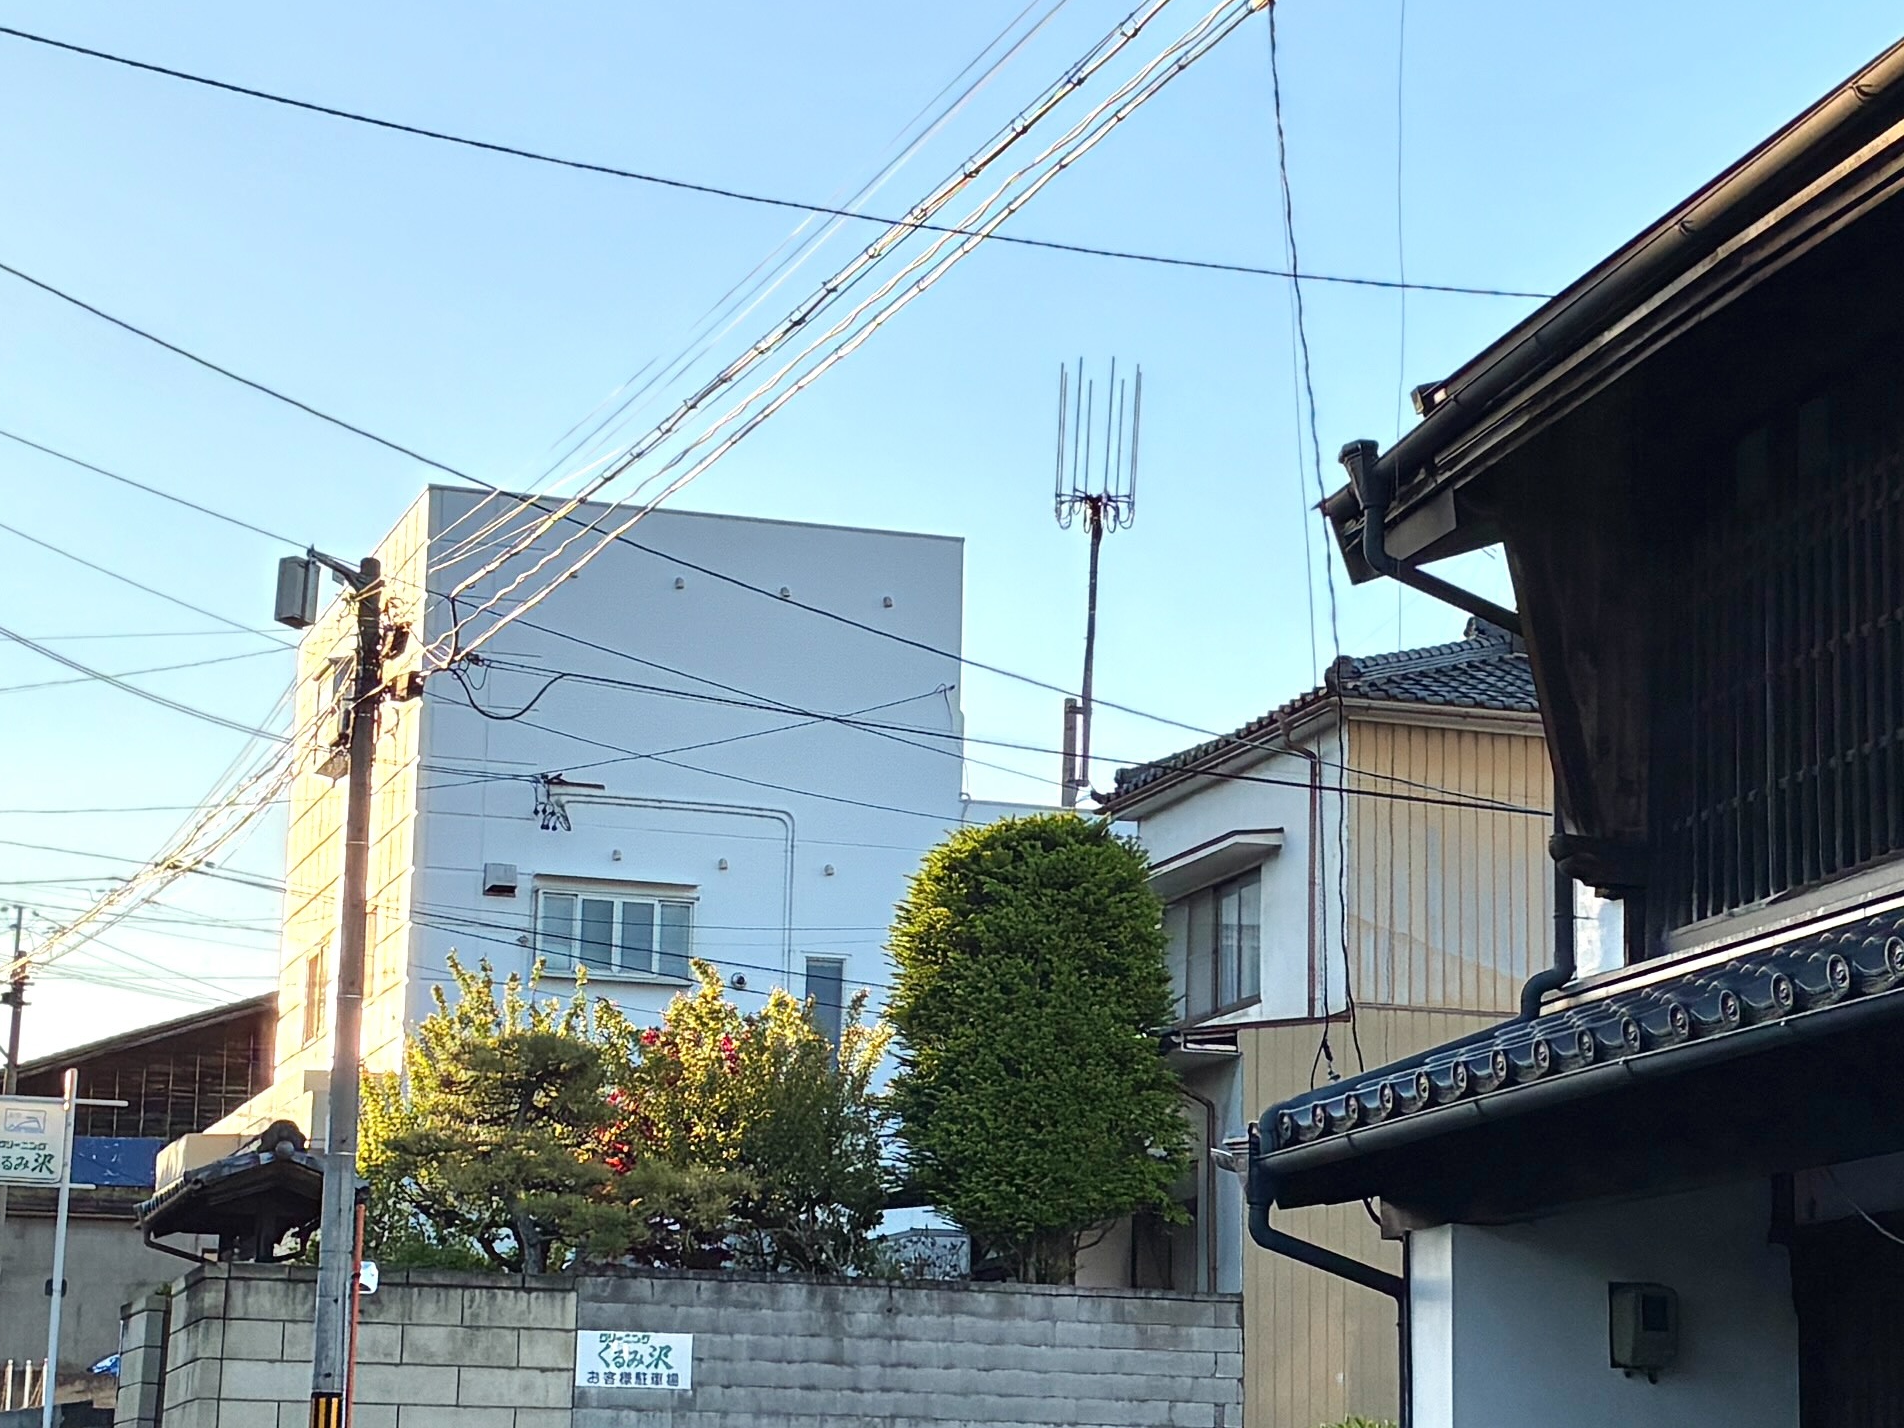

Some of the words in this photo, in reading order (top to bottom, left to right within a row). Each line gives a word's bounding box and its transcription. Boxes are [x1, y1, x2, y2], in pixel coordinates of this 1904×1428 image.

[599, 1333, 651, 1344] クリーニング
[598, 1343, 674, 1370] くるみ沢
[587, 1370, 679, 1387] お客様駐車場
